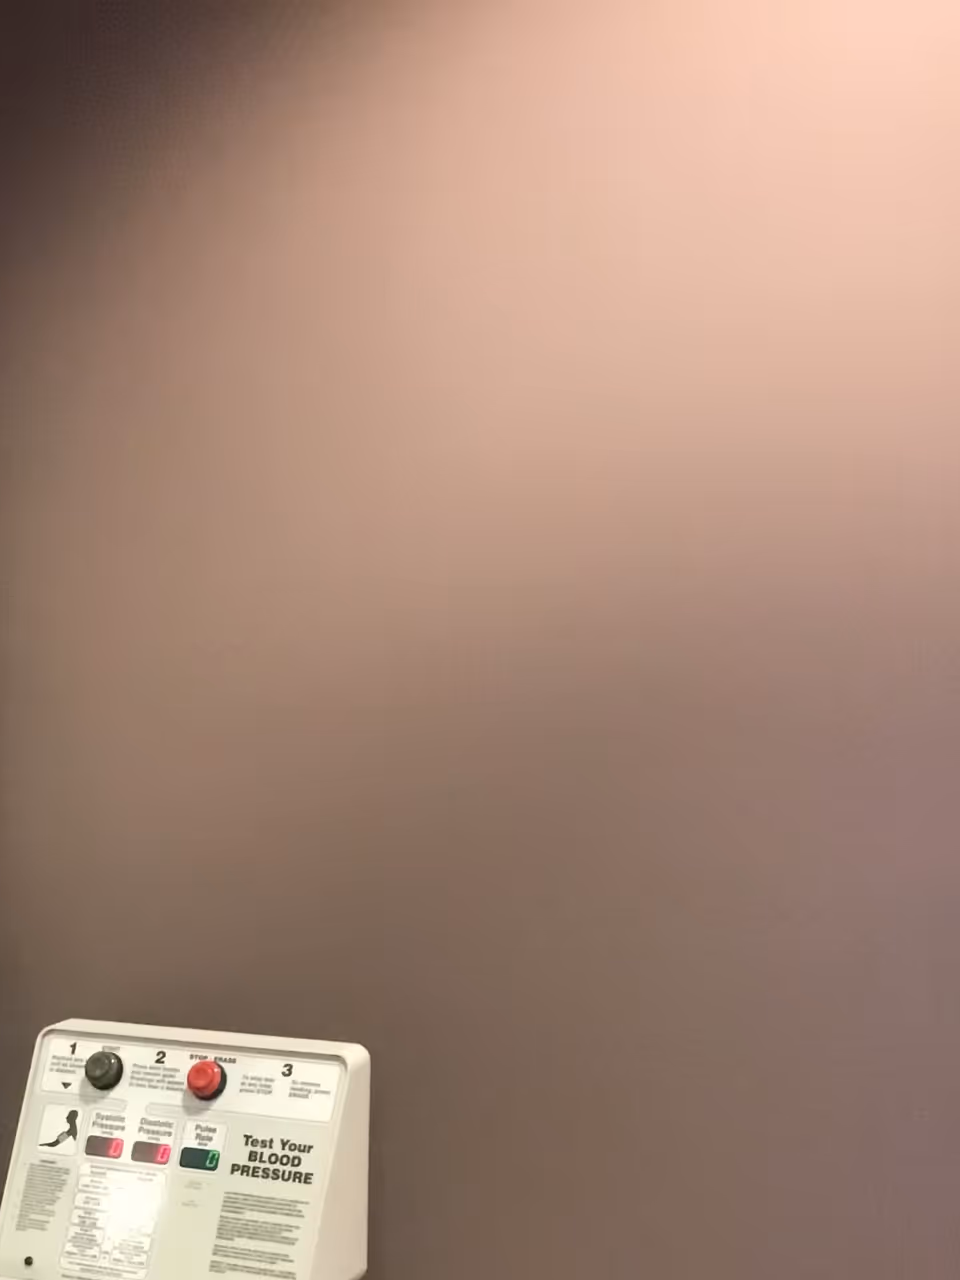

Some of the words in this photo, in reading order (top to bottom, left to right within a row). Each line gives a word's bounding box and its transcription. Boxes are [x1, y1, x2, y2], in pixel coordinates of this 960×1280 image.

[69, 1042, 77, 1055] 1
[154, 1050, 166, 1064] 2
[281, 1063, 294, 1077] 3
[92, 1121, 126, 1131] Pressure
[138, 1126, 173, 1137] Pressure
[195, 1123, 217, 1134] Pulse
[195, 1132, 213, 1142] Rate
[243, 1134, 274, 1149] Test
[280, 1138, 314, 1154] Your
[109, 1138, 123, 1158] 0
[205, 1150, 219, 1168] 0
[247, 1150, 302, 1168] BLOOD
[230, 1163, 314, 1185] PRESSURE
